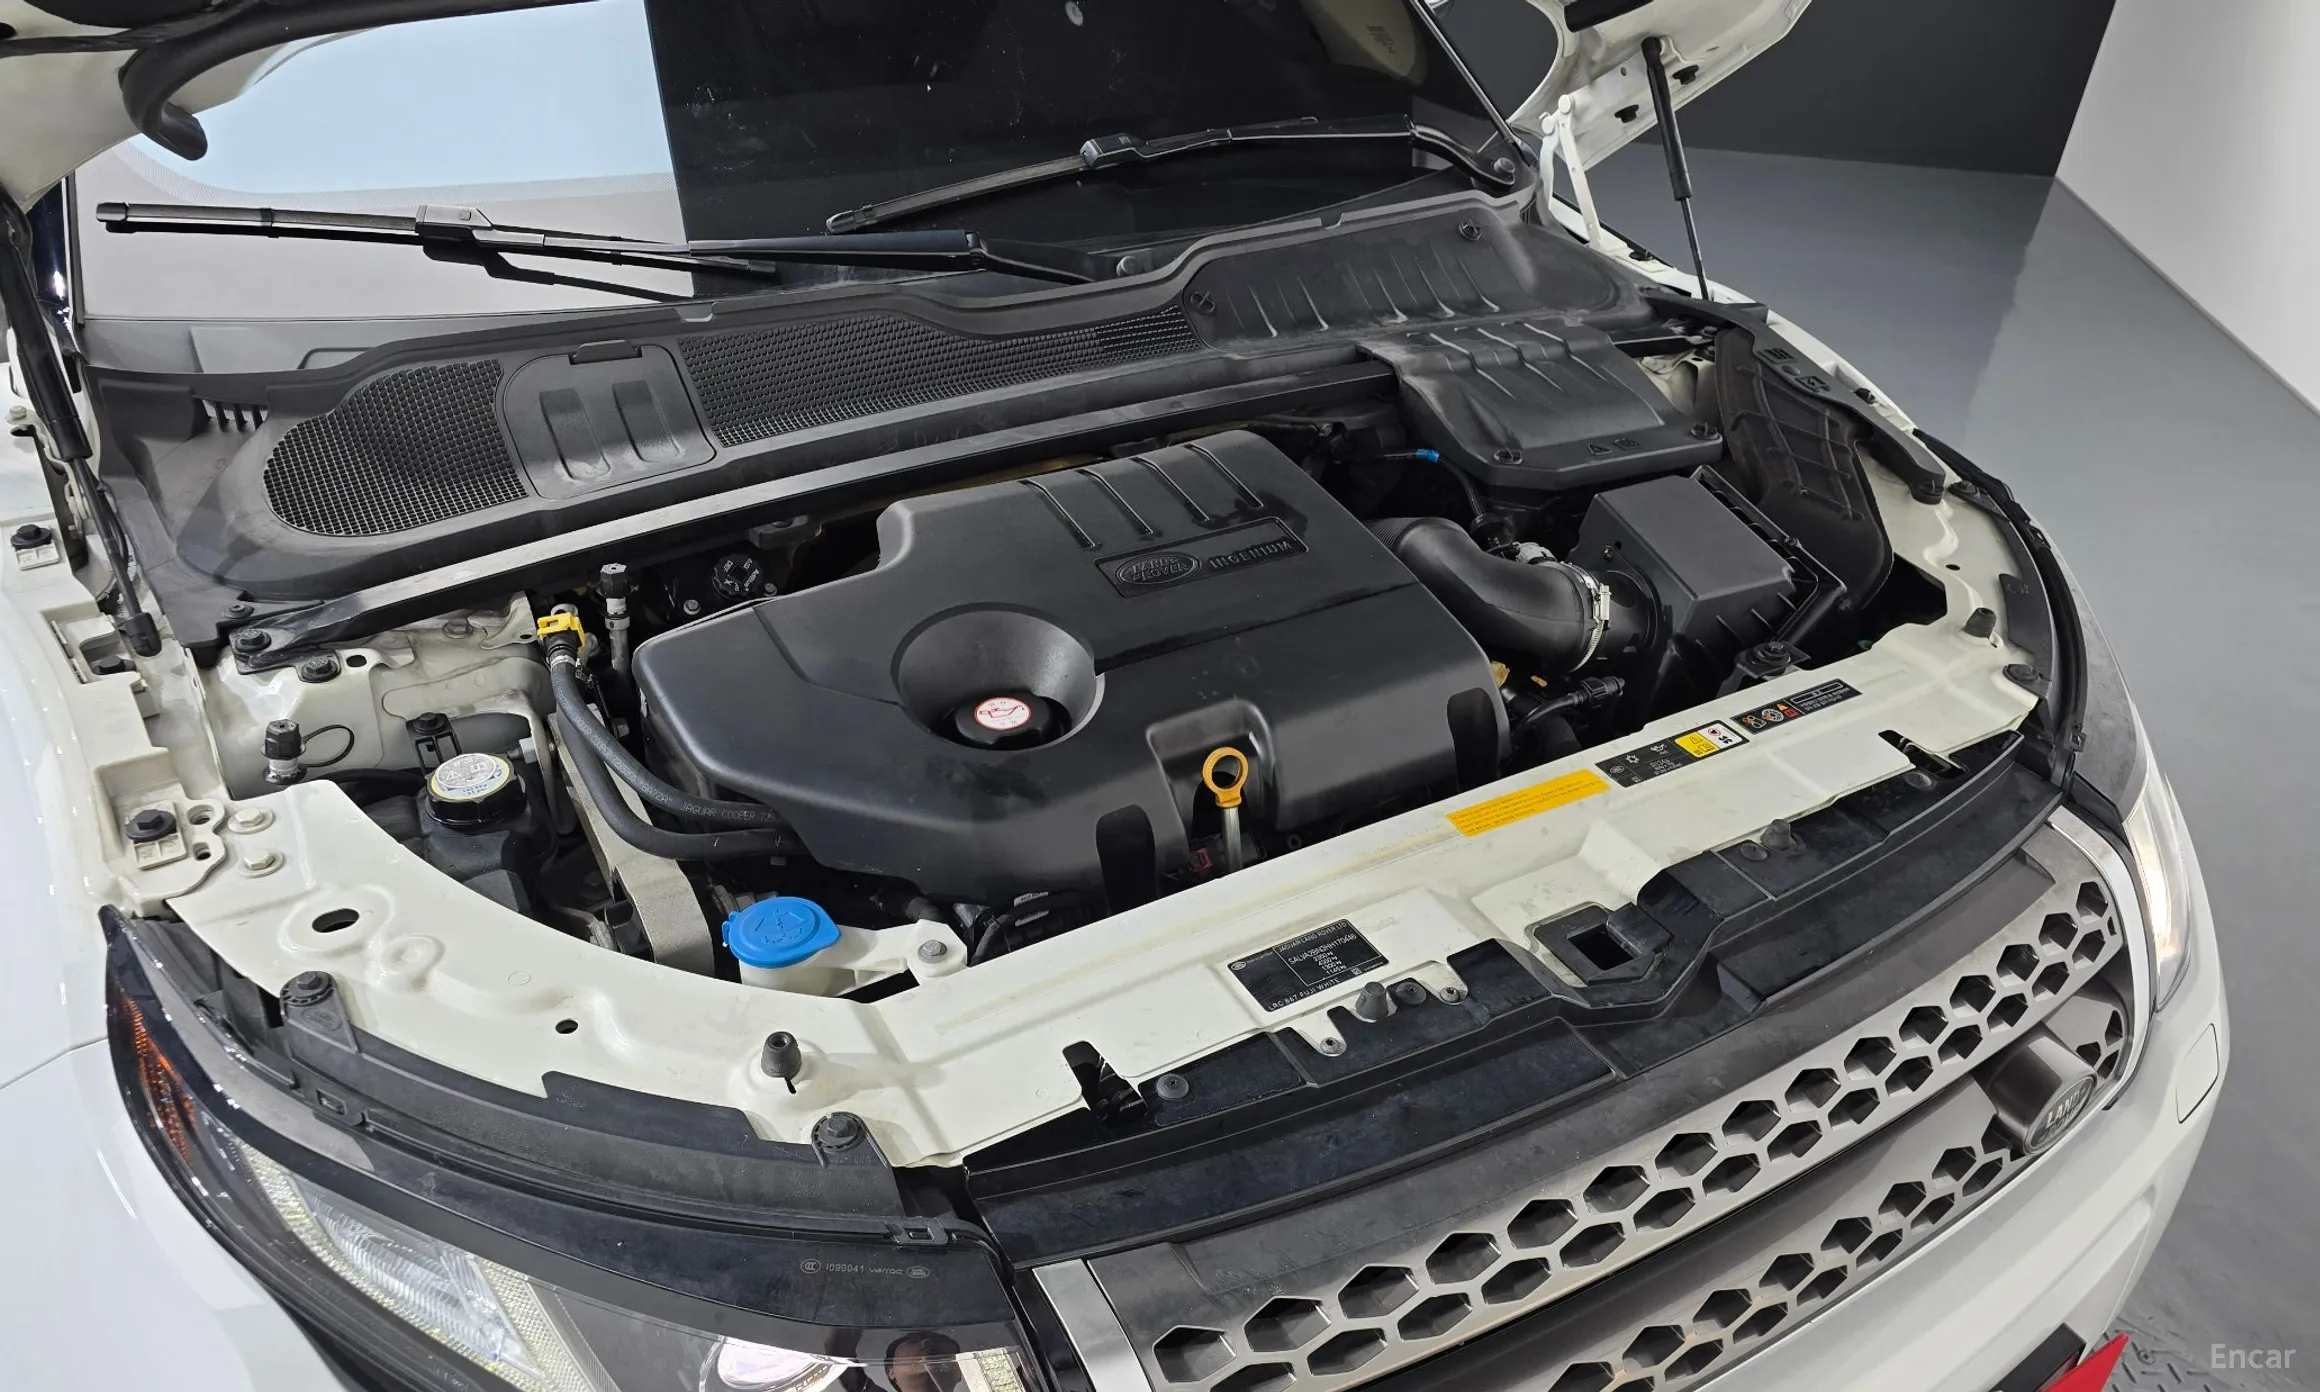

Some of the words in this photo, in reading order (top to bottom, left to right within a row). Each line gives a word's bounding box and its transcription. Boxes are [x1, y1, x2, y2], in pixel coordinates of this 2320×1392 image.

[1209, 540, 1292, 569] INGENIUM
[680, 801, 718, 818] JAGUAR
[1268, 1000, 1284, 1011] LRC
[1300, 986, 1317, 997] FUJI
[1317, 977, 1340, 990] WHITE
